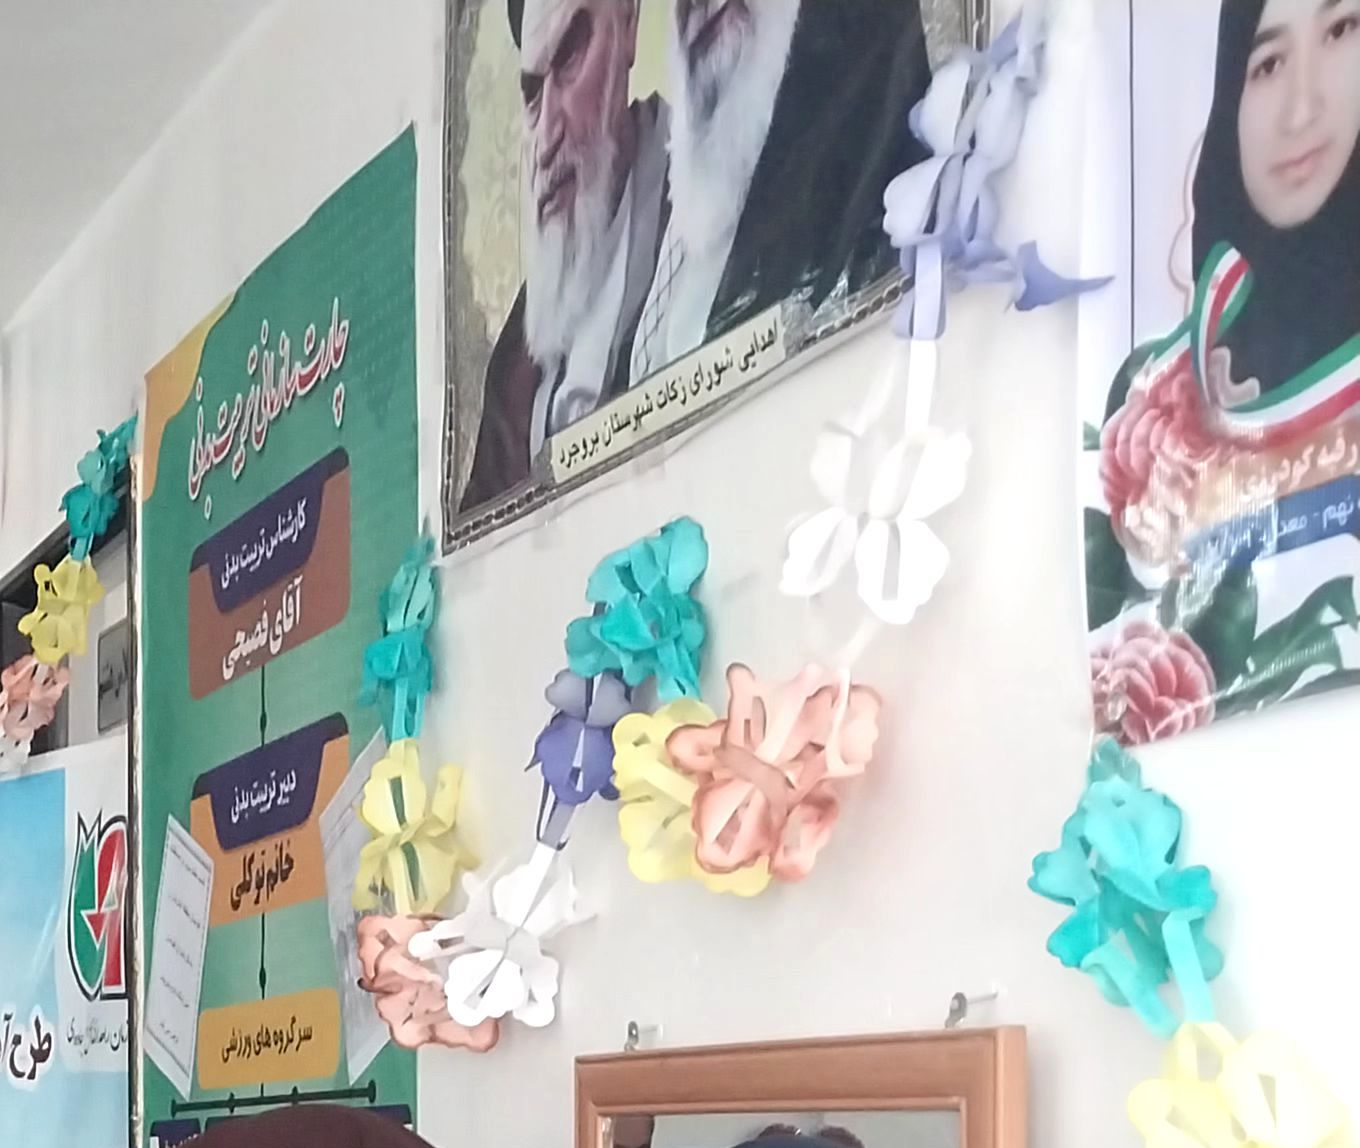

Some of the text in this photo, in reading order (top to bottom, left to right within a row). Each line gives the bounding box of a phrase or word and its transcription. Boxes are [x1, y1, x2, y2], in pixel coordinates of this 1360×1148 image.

[559, 317, 779, 469] اهدایی شورای زکات شهرستان بروجرد
[220, 496, 308, 590] کارشناس تربیت بدنی
[269, 573, 304, 656] آقای
[230, 769, 297, 824] دبیر تربیت بدنی
[229, 848, 266, 912] توکلی
[266, 837, 295, 902] خانم
[8, 1014, 53, 1081] طرح
[221, 1026, 253, 1064] ورزشی
